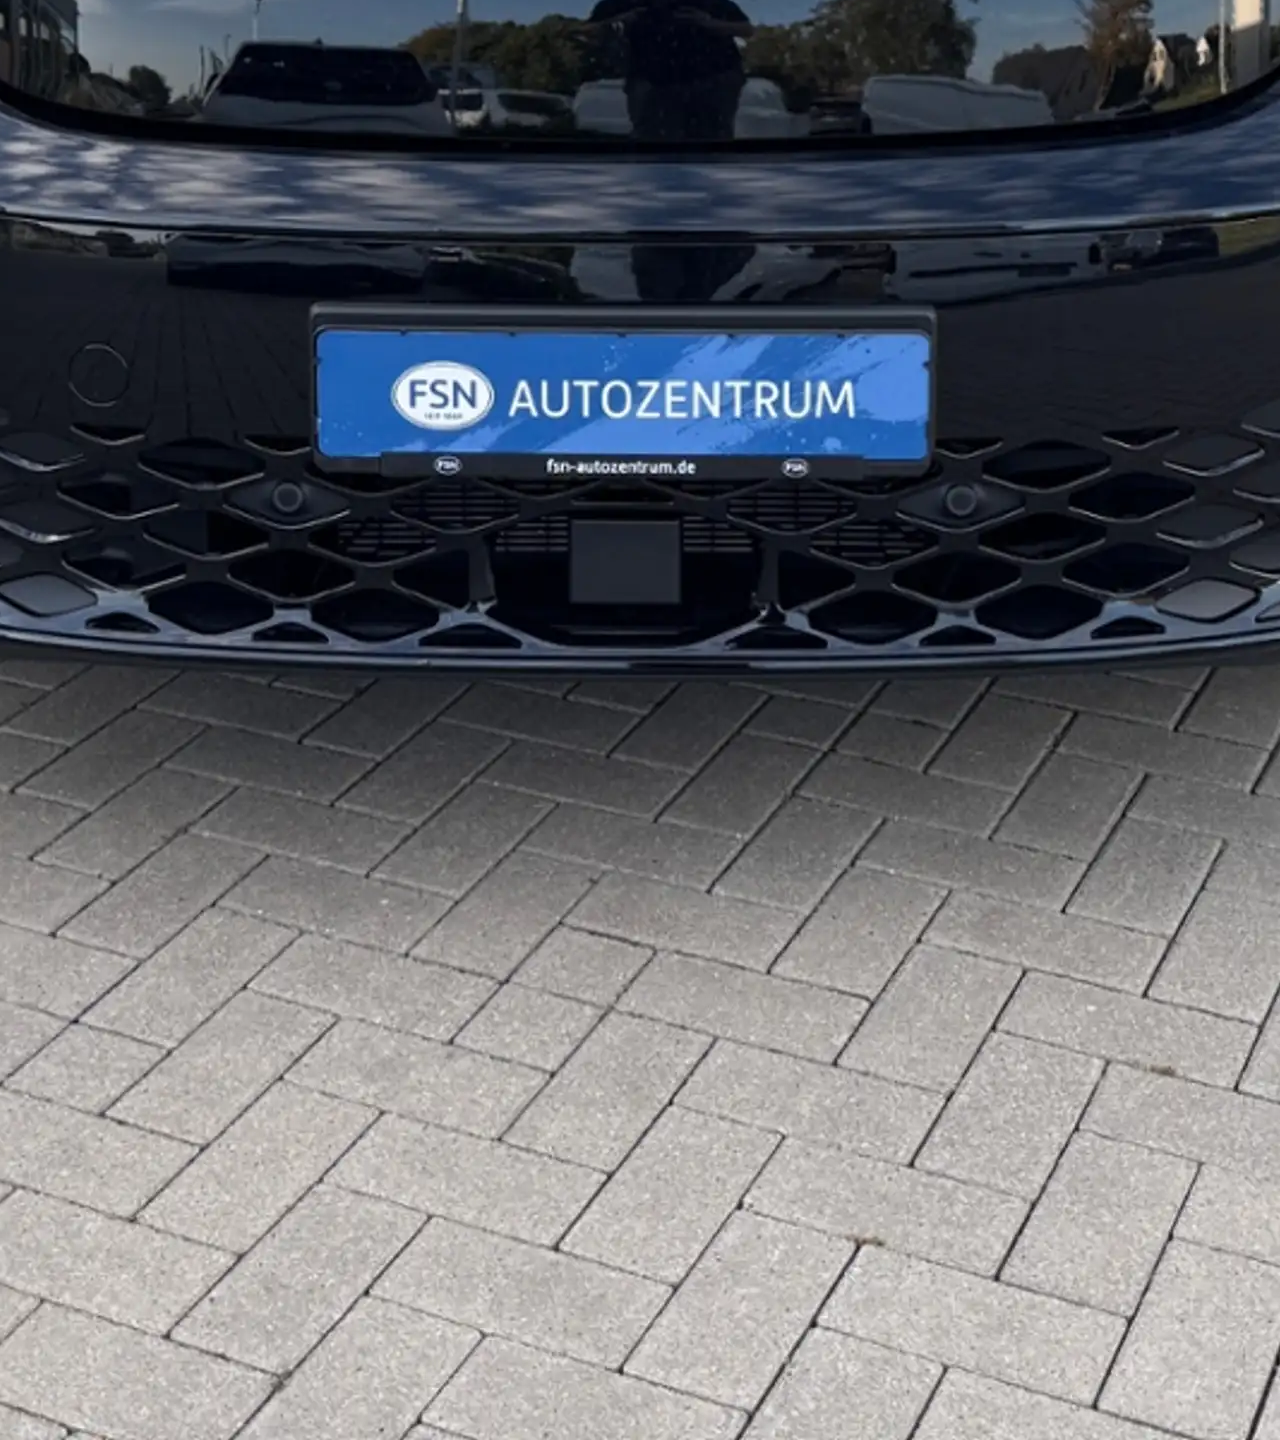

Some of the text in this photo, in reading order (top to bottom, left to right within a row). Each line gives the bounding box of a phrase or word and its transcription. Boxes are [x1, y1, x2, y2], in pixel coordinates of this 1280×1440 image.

[408, 378, 857, 419] FSN AUTOZENTRUM
[546, 457, 697, 476] fsn-autozentrum.de
